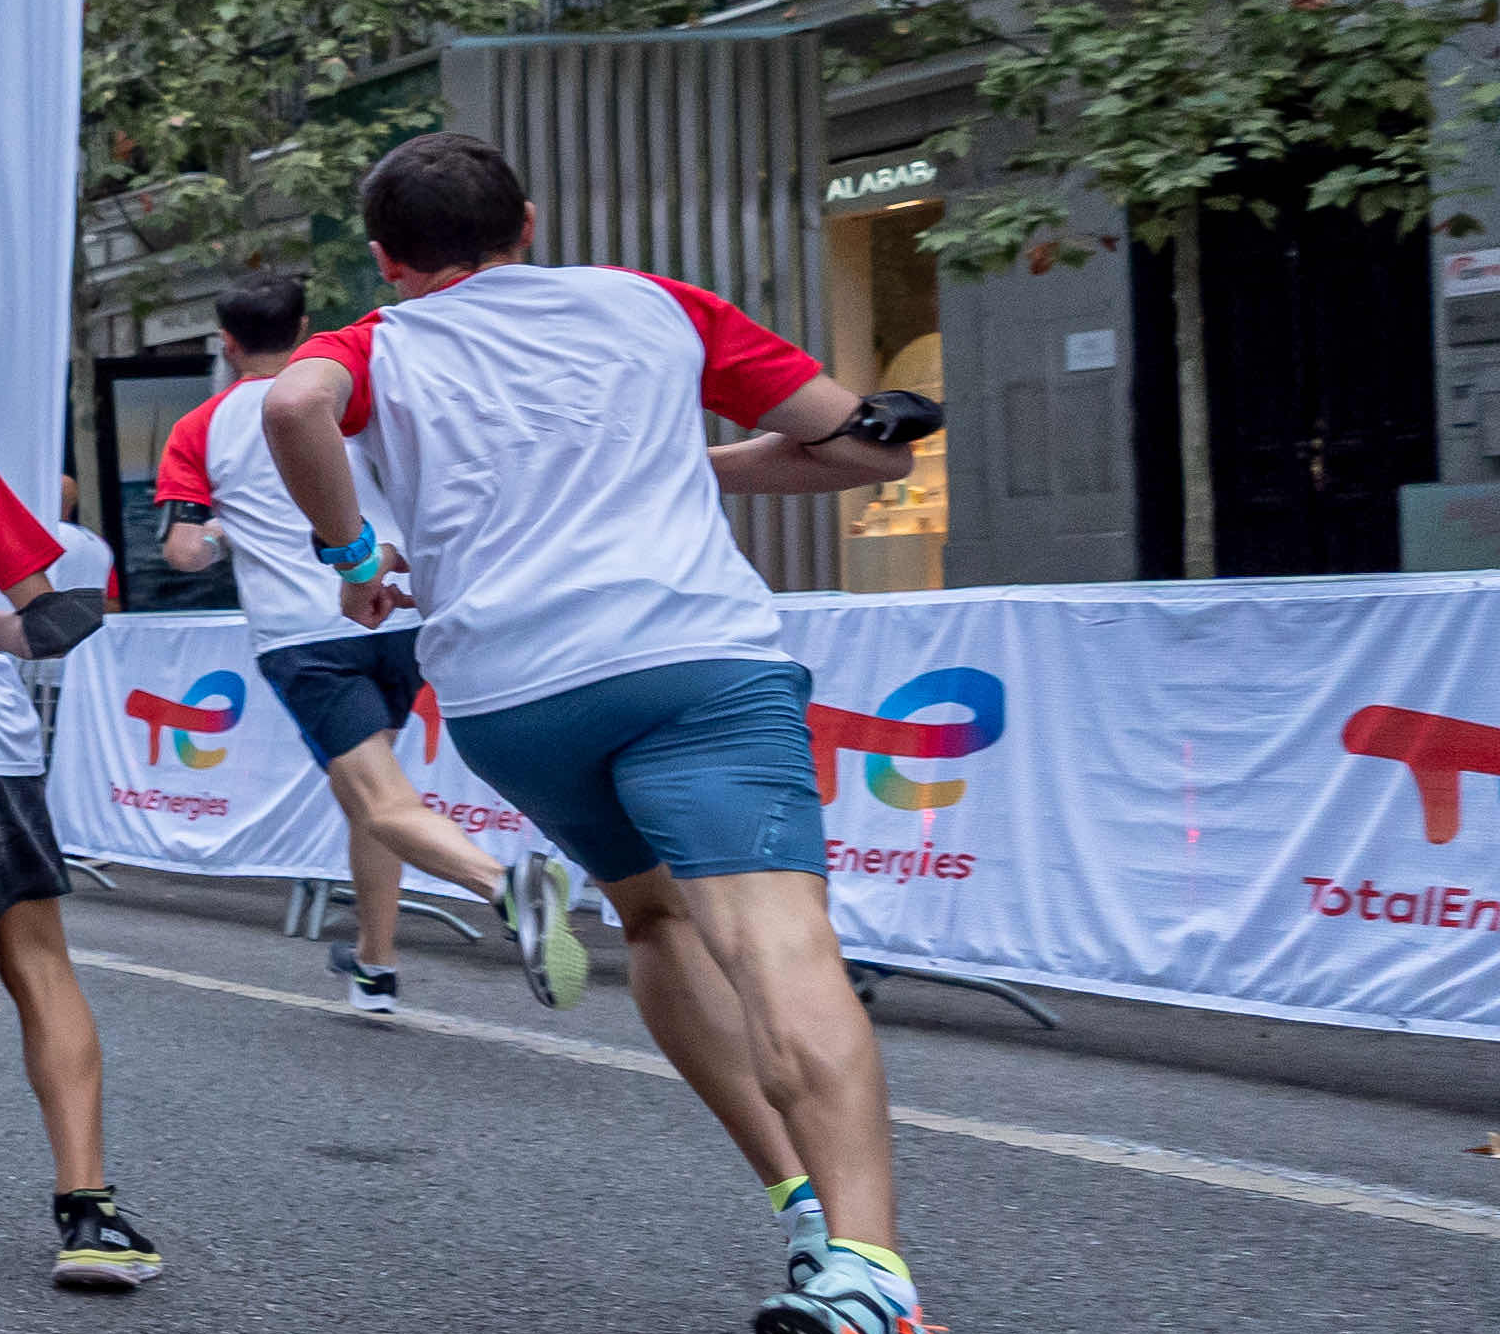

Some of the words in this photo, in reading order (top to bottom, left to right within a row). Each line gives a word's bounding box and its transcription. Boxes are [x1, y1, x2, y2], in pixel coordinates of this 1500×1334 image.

[826, 160, 938, 203] ALABAB
[825, 839, 977, 885] Energies
[1303, 876, 1500, 932] TotalEn
